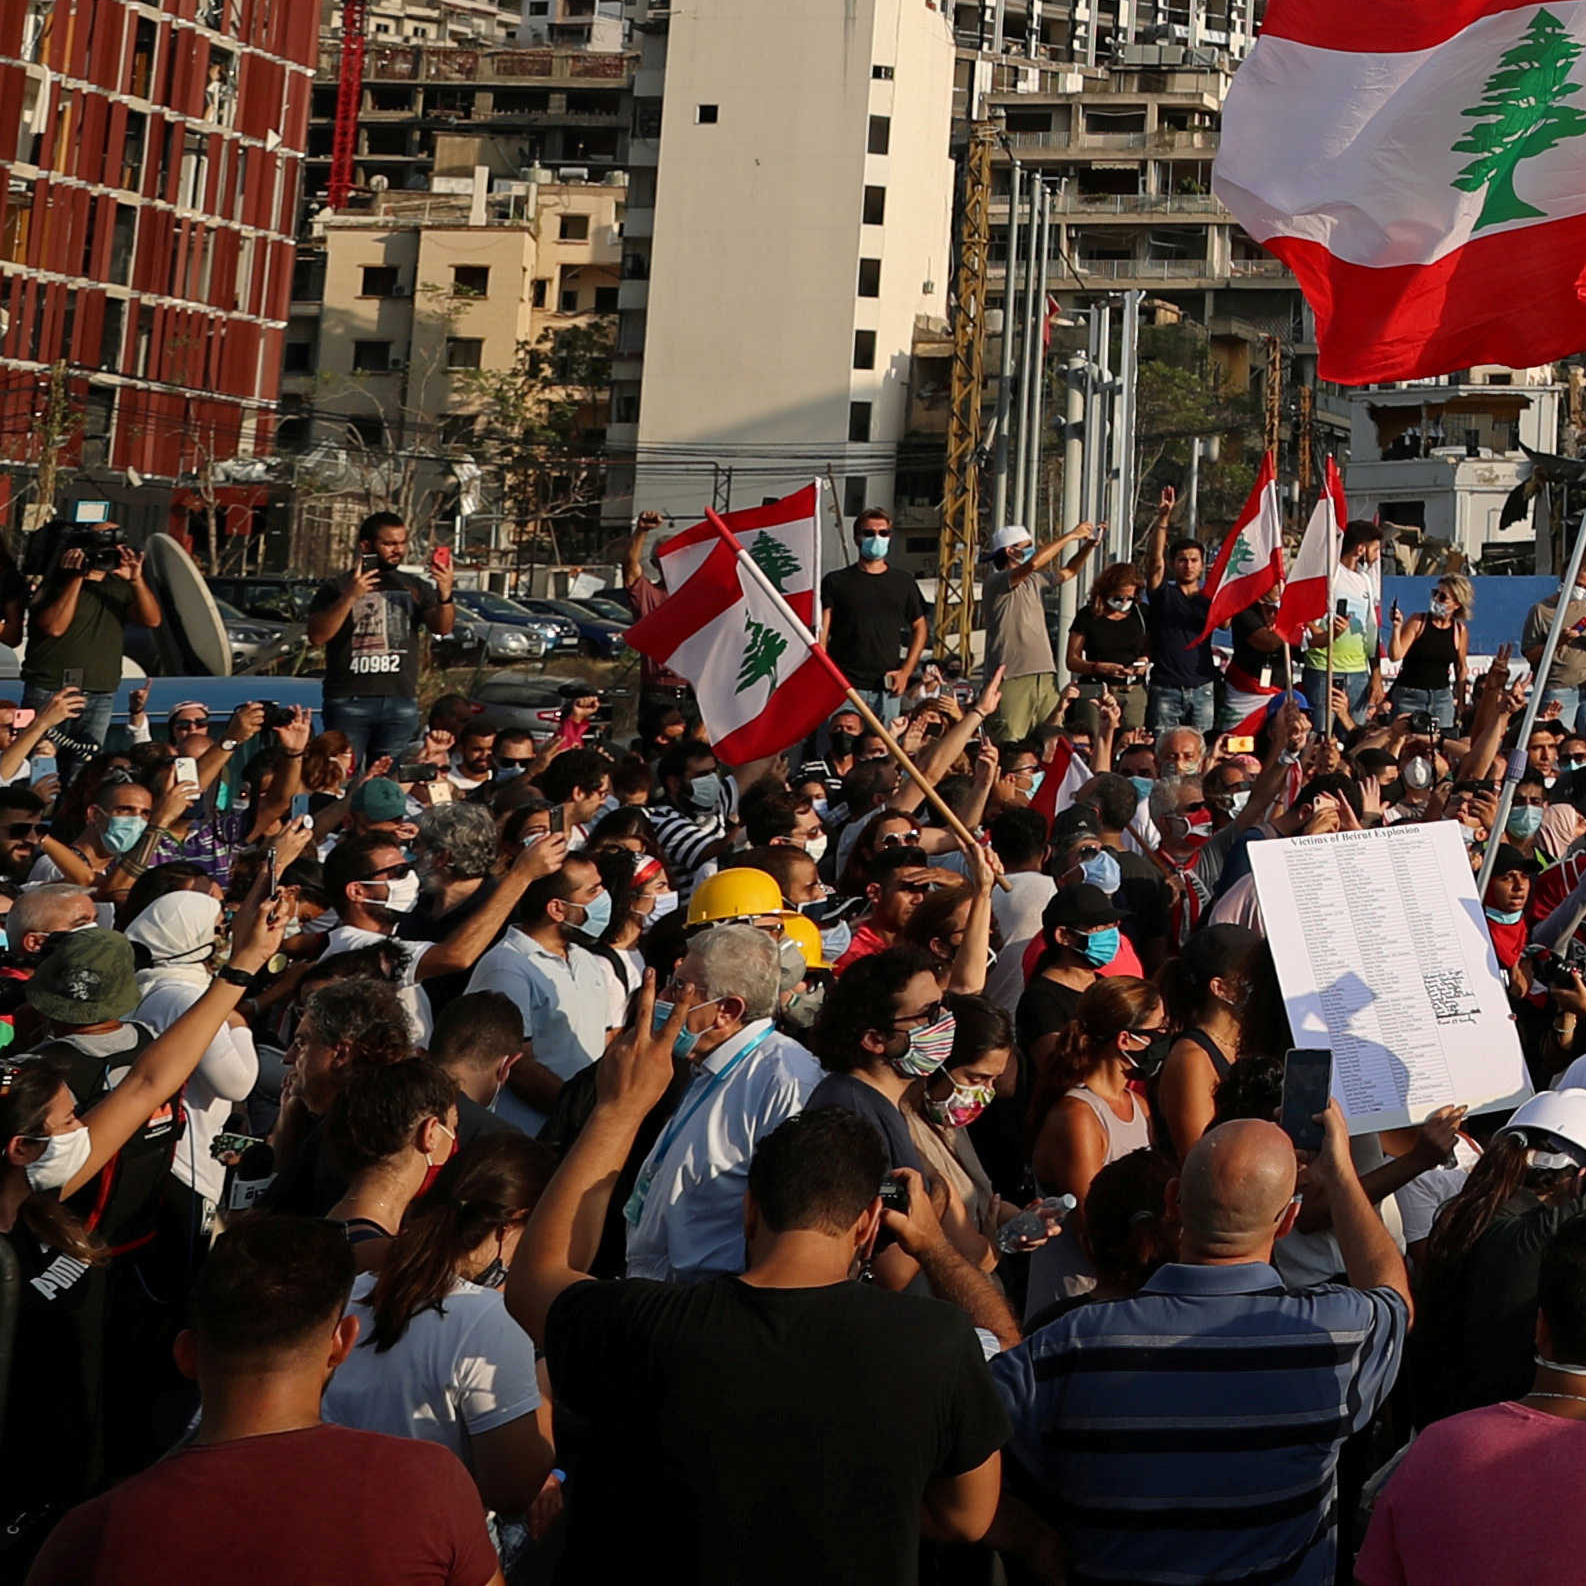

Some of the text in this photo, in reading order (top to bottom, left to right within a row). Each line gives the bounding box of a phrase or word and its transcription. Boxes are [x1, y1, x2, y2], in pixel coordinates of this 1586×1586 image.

[350, 655, 400, 674] 40982
[1291, 826, 1420, 846] Victims of Beirut Explosion
